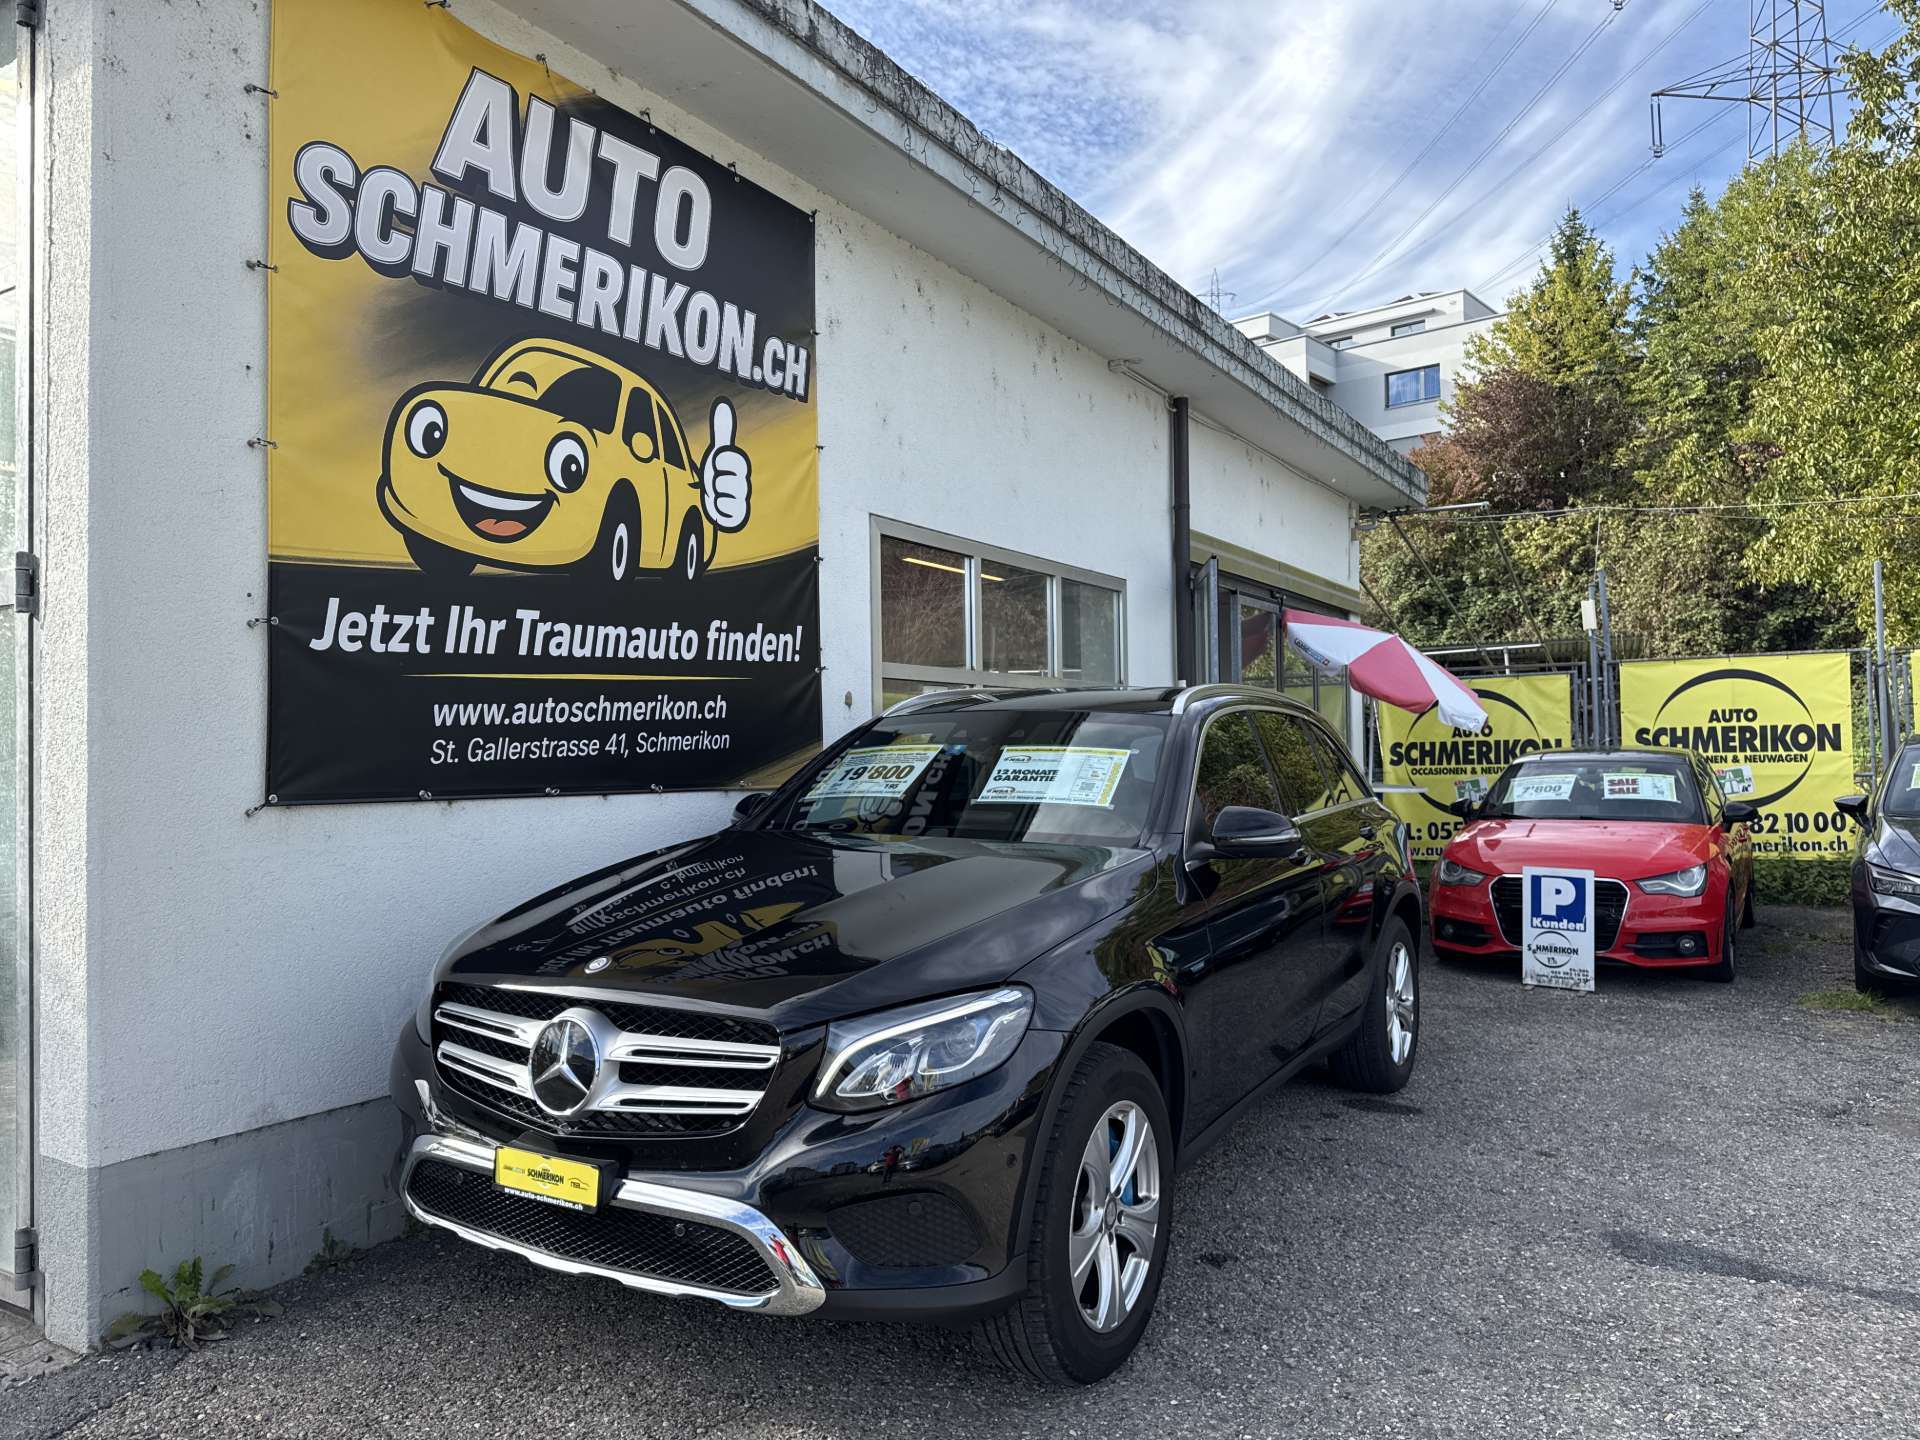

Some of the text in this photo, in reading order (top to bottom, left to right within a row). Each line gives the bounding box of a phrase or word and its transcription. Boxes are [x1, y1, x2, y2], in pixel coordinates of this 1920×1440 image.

[433, 67, 712, 271] AUTO
[288, 142, 809, 399] SCHMERIKON.CH
[309, 597, 803, 663] Jetzt Ihr Traumauto finden!
[433, 695, 727, 726] www.autoschmerikon.ch
[1708, 708, 1758, 723] AUTO
[430, 730, 730, 764] St. Gallerstrasse 41, Schmerikon
[1635, 723, 1842, 755] SCHMERIKON
[1744, 754, 1809, 764] NEUWAGEN
[840, 764, 915, 781] 19'800
[1411, 767, 1467, 776] OCCASIONEN
[1470, 767, 1477, 775] &
[1608, 778, 1639, 786] SALE
[1608, 787, 1640, 795] SALE
[1750, 811, 1779, 834] 82
[1541, 876, 1576, 916] P
[1532, 917, 1585, 932] Kunden
